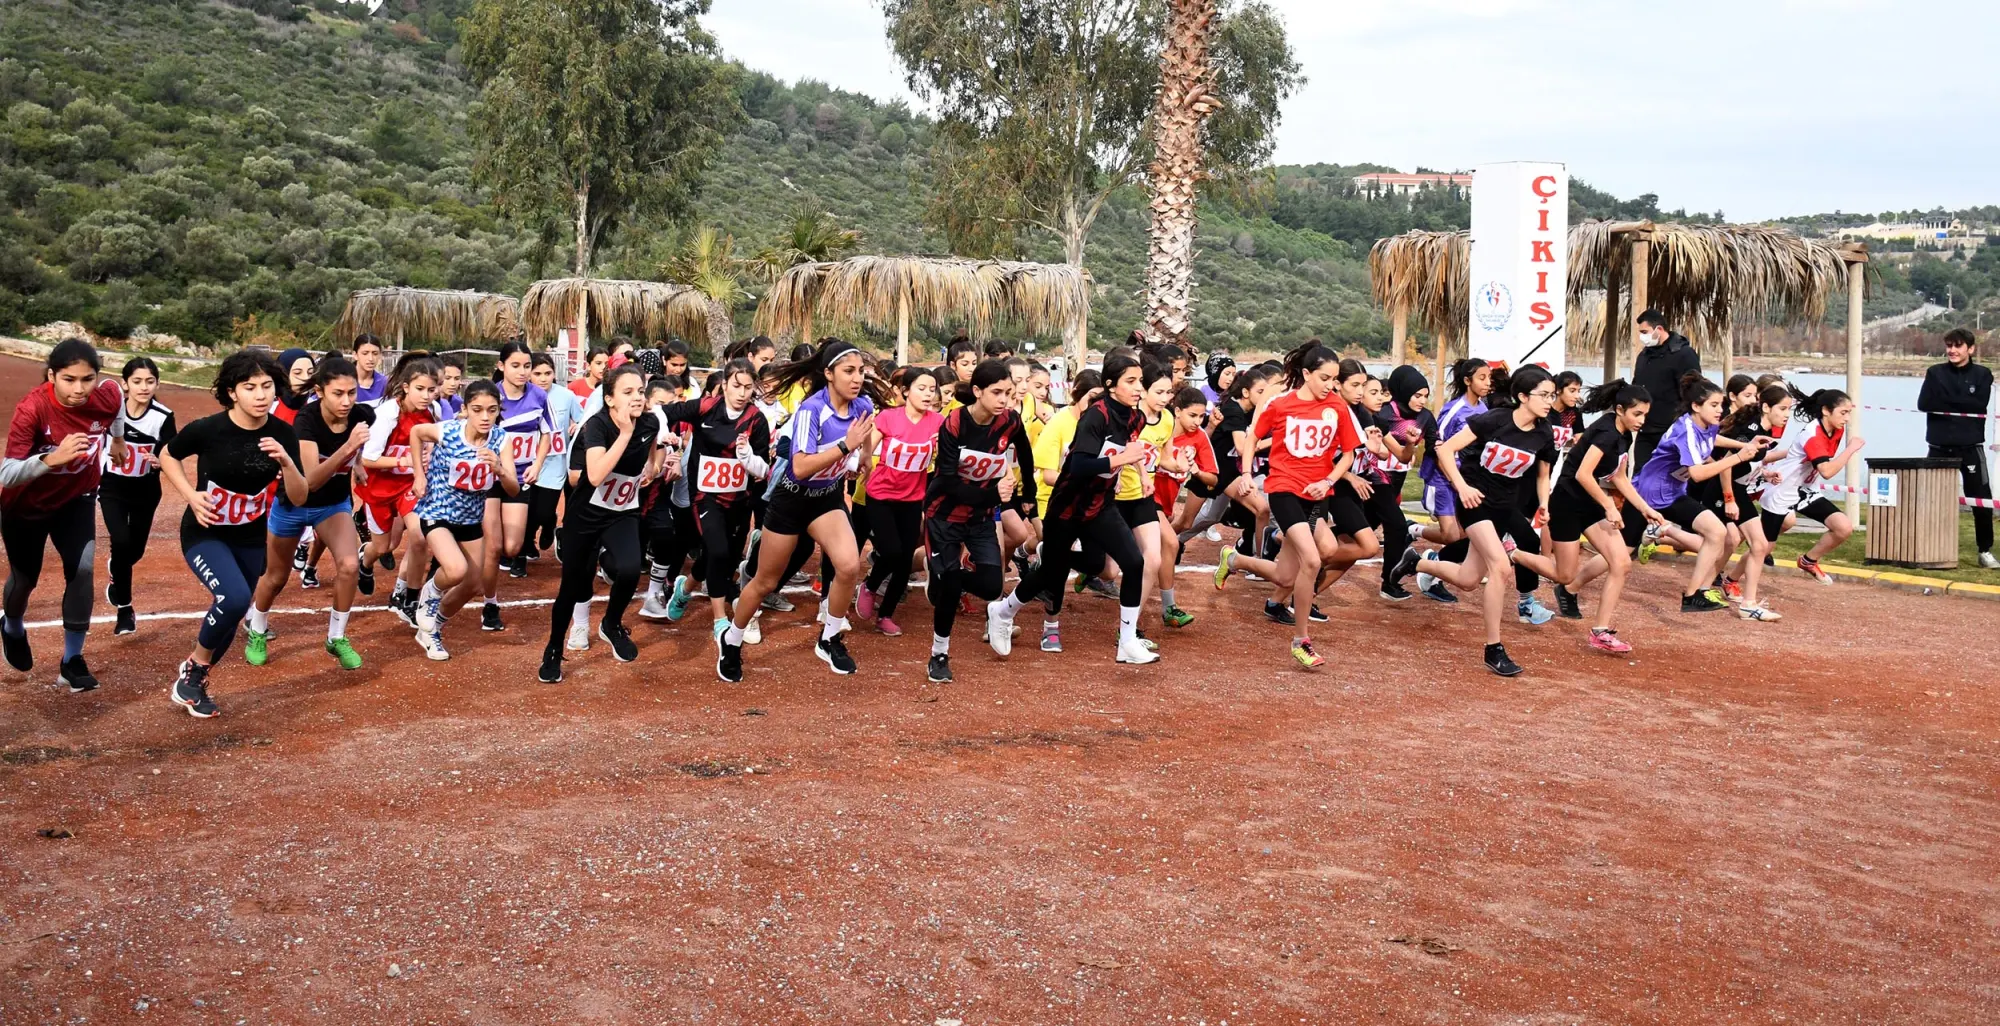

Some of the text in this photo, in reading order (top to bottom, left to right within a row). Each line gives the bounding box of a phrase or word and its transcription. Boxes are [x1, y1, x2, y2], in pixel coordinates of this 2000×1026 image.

[1529, 176, 1557, 330] ÇIKIŞ
[1290, 424, 1332, 451] 138
[892, 443, 931, 470] 177
[958, 455, 1005, 480] 287
[1484, 444, 1530, 476] 127
[454, 461, 494, 490] 20
[702, 461, 745, 488] 289
[209, 487, 265, 524] 203
[193, 554, 226, 626] NIKE AIR
